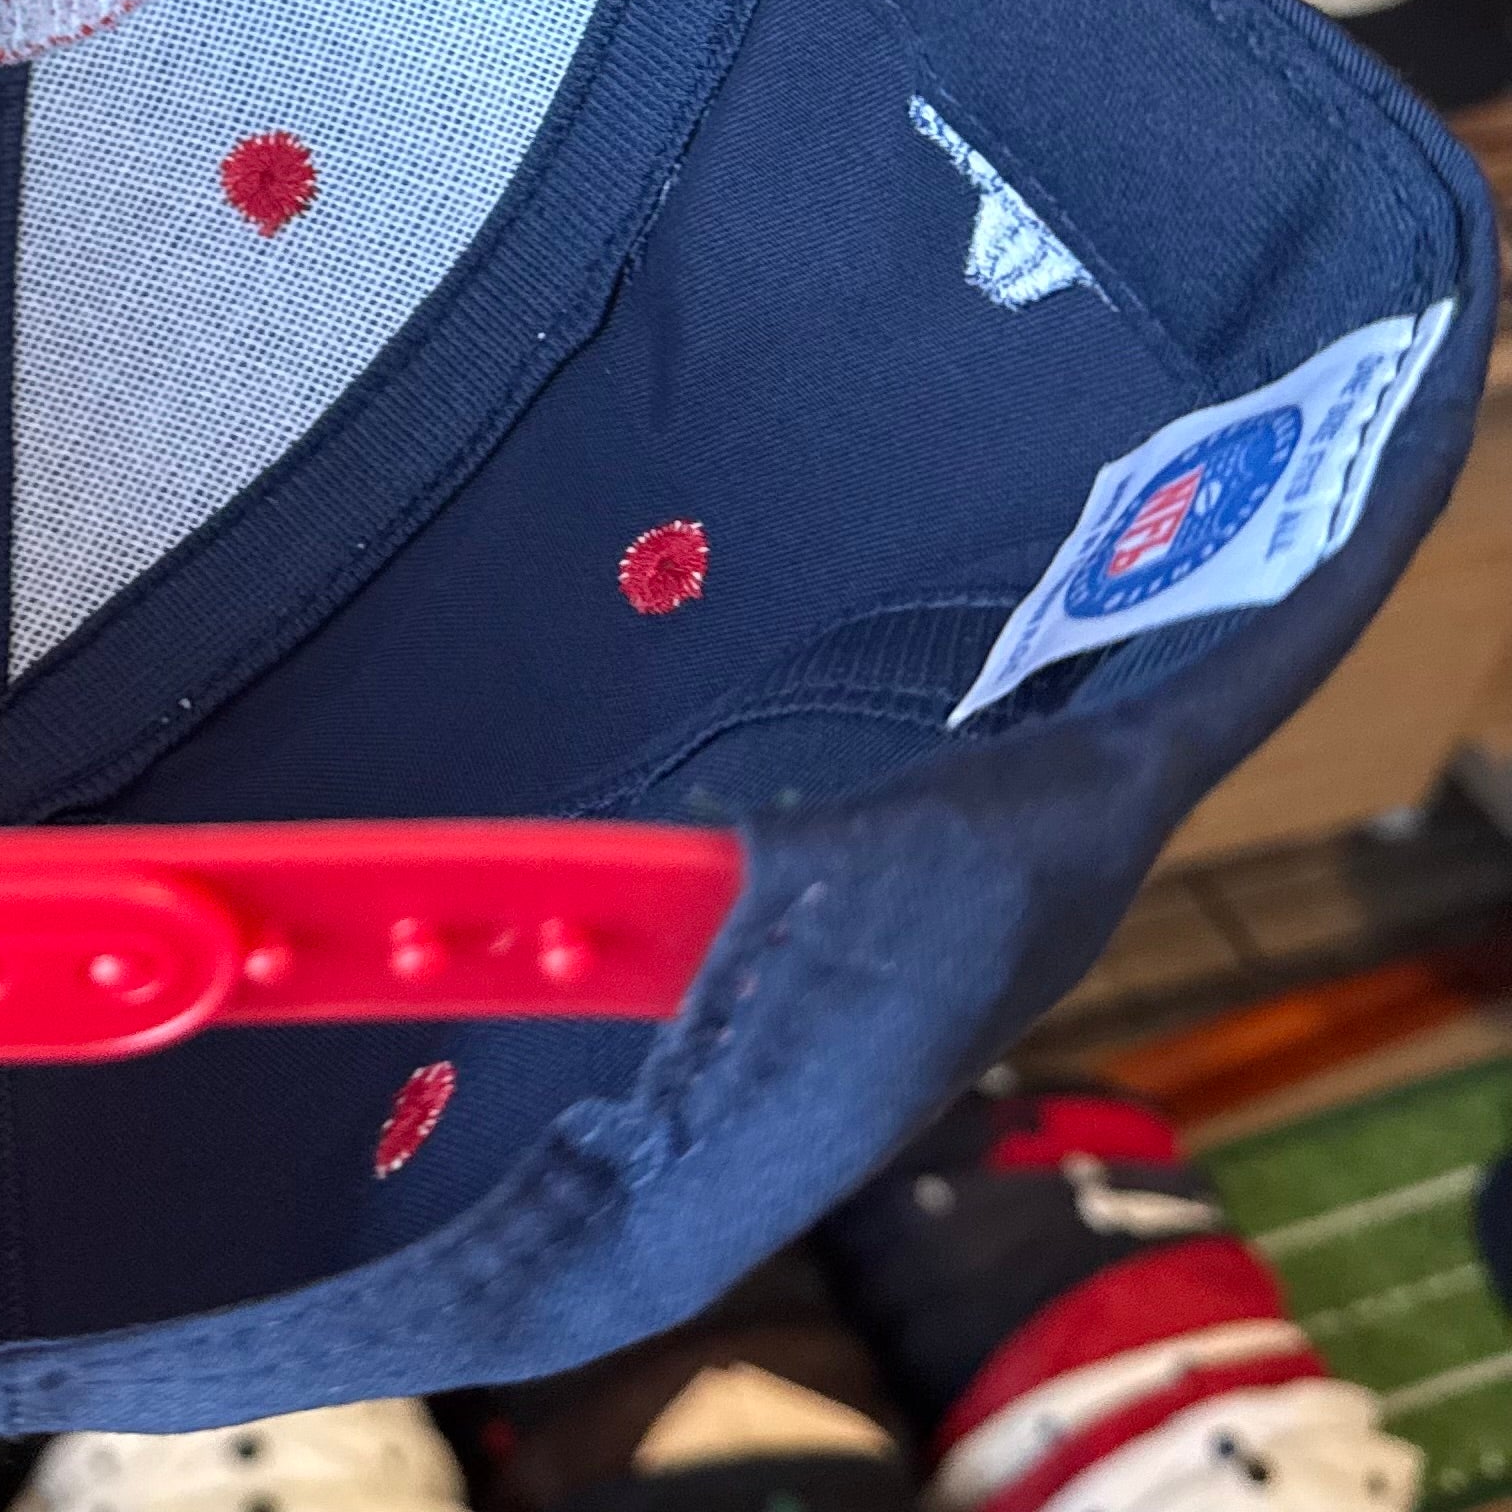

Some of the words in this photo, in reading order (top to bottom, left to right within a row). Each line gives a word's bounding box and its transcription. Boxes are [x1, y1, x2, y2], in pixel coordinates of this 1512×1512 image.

[1340, 353, 1385, 396] ONE
[1108, 465, 1204, 574] NFL
[1265, 510, 1304, 561] ALL
